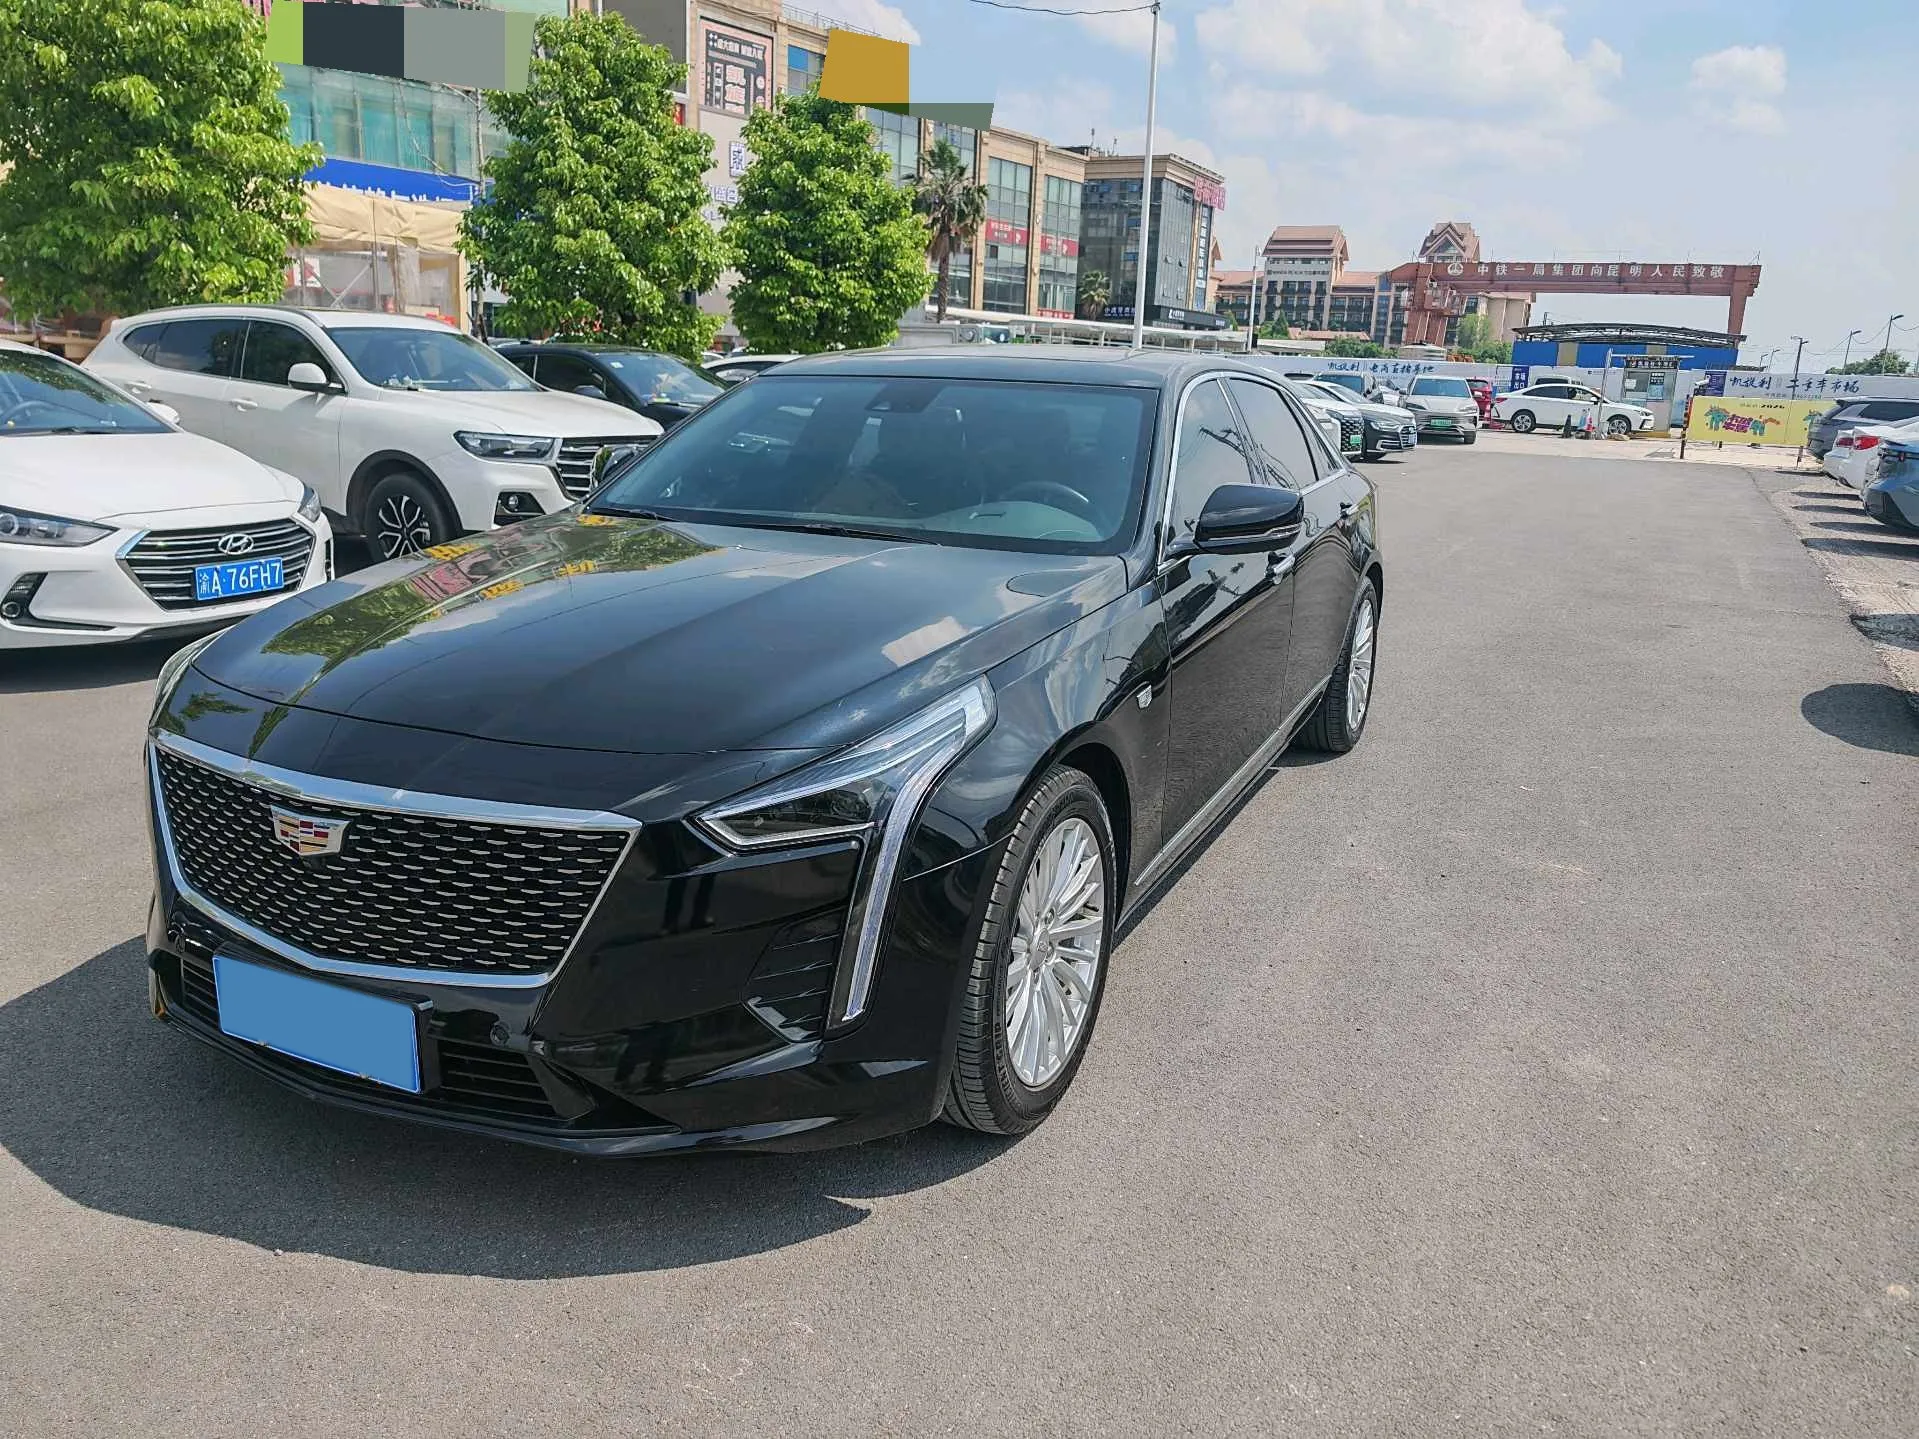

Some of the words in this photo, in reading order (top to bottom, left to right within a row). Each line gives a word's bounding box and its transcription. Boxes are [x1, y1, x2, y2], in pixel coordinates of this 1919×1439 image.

[1476, 263, 1726, 278] 中铁一局集团向昆明人民致敬
[1785, 378, 1860, 394] 二手车市场
